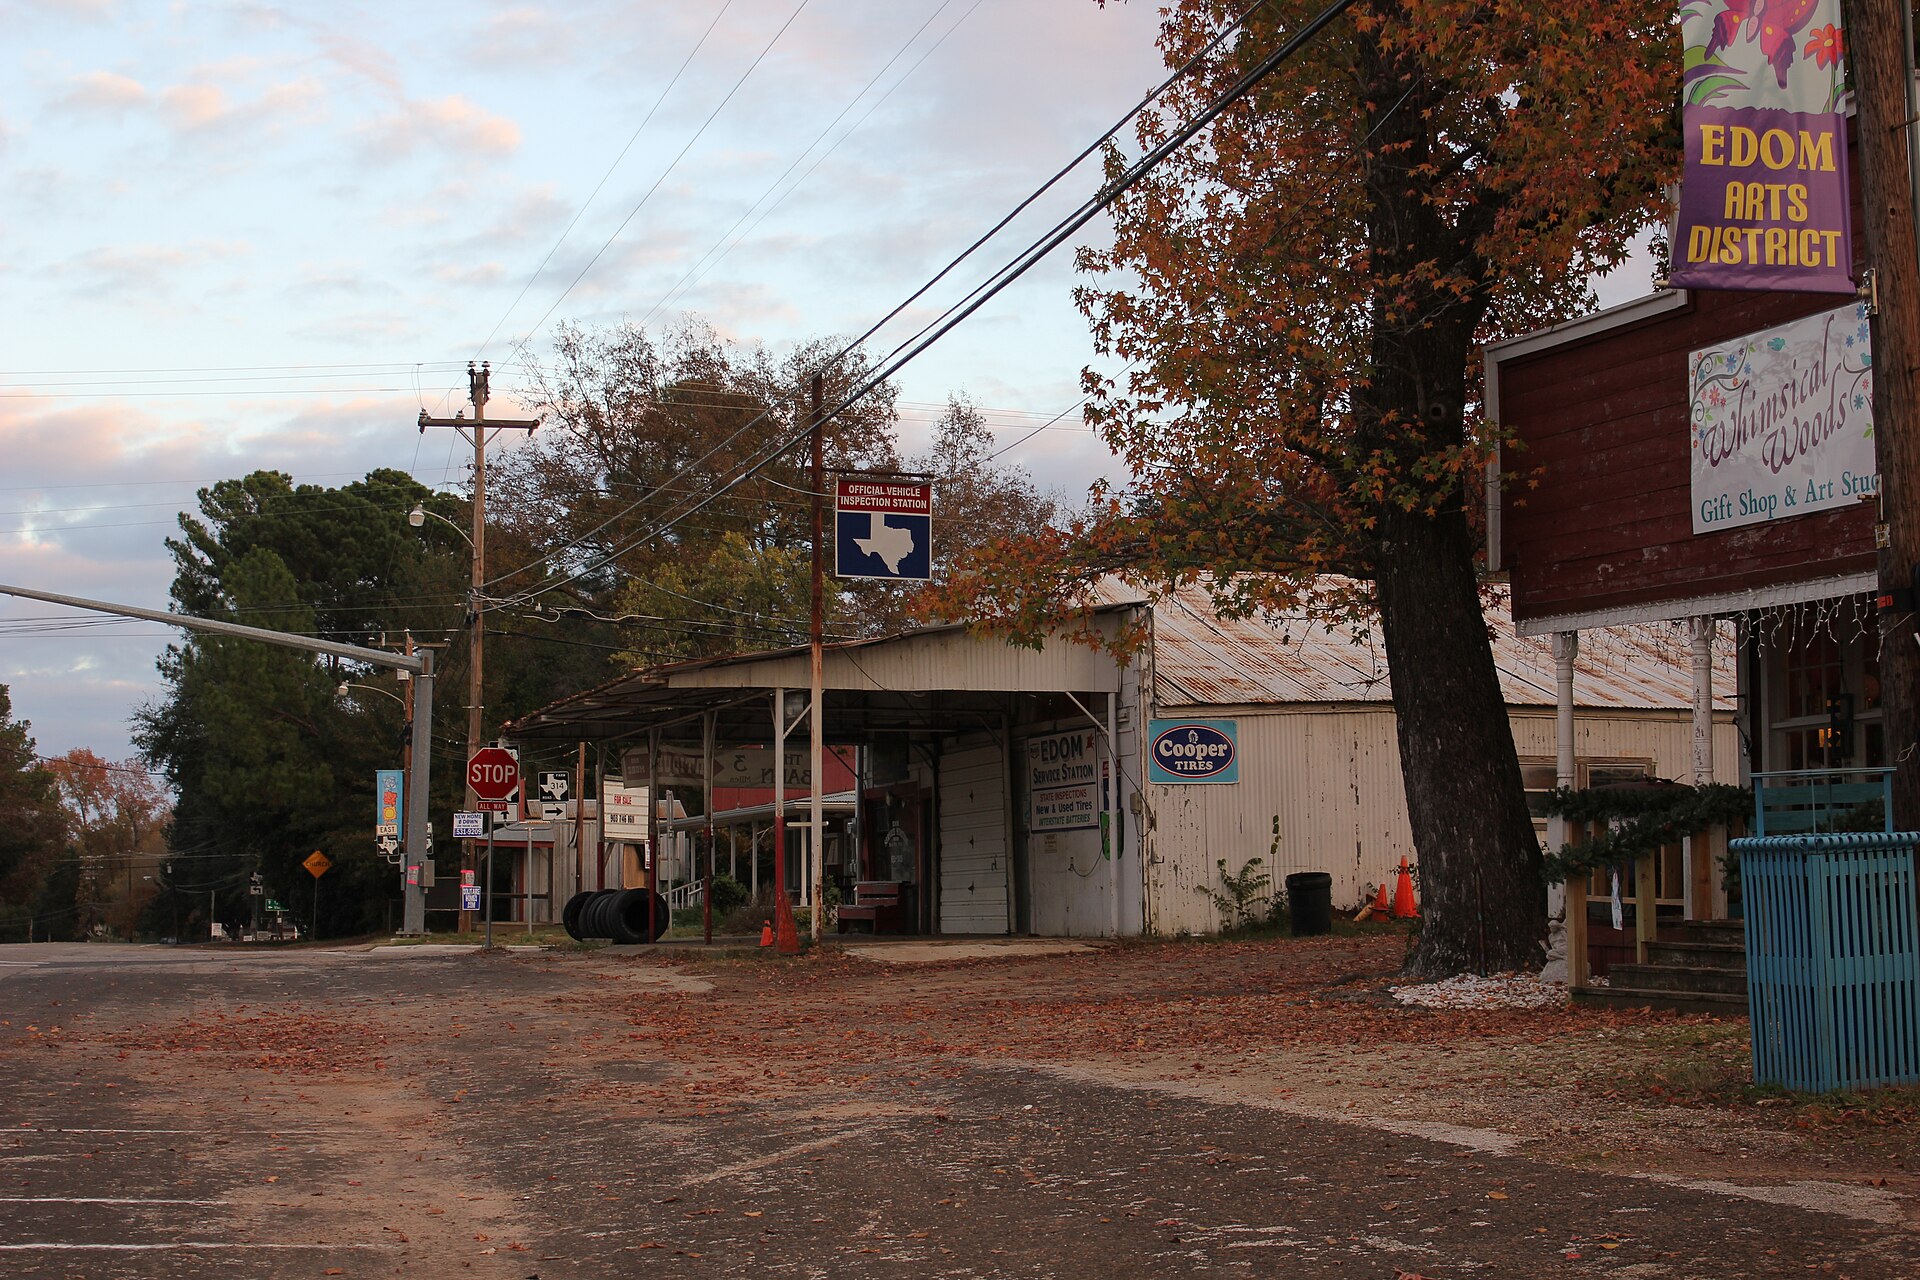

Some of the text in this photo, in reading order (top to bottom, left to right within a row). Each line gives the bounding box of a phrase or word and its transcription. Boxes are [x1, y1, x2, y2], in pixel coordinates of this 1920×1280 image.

[1699, 124, 1836, 172] EDOM
[1724, 180, 1808, 222] ARTS
[1687, 225, 1842, 267] DISTRICT
[1702, 314, 1834, 468] Whimsical
[1762, 362, 1847, 475] Woods
[848, 484, 921, 497] OFFICIAL VEHICLE
[1701, 470, 1878, 523] Gift Shop & Art Stu
[840, 496, 927, 509] INSPECTION STATION
[1040, 734, 1083, 763] EDOM
[1159, 739, 1228, 760] Cooper
[471, 763, 516, 784] STOP
[1174, 760, 1214, 771] TIRES
[622, 796, 632, 805] SALE
[1040, 788, 1087, 802] STATE INSPECTIONS
[1036, 800, 1092, 815] New & Used Tires
[1066, 813, 1091, 825] BATTERIES
